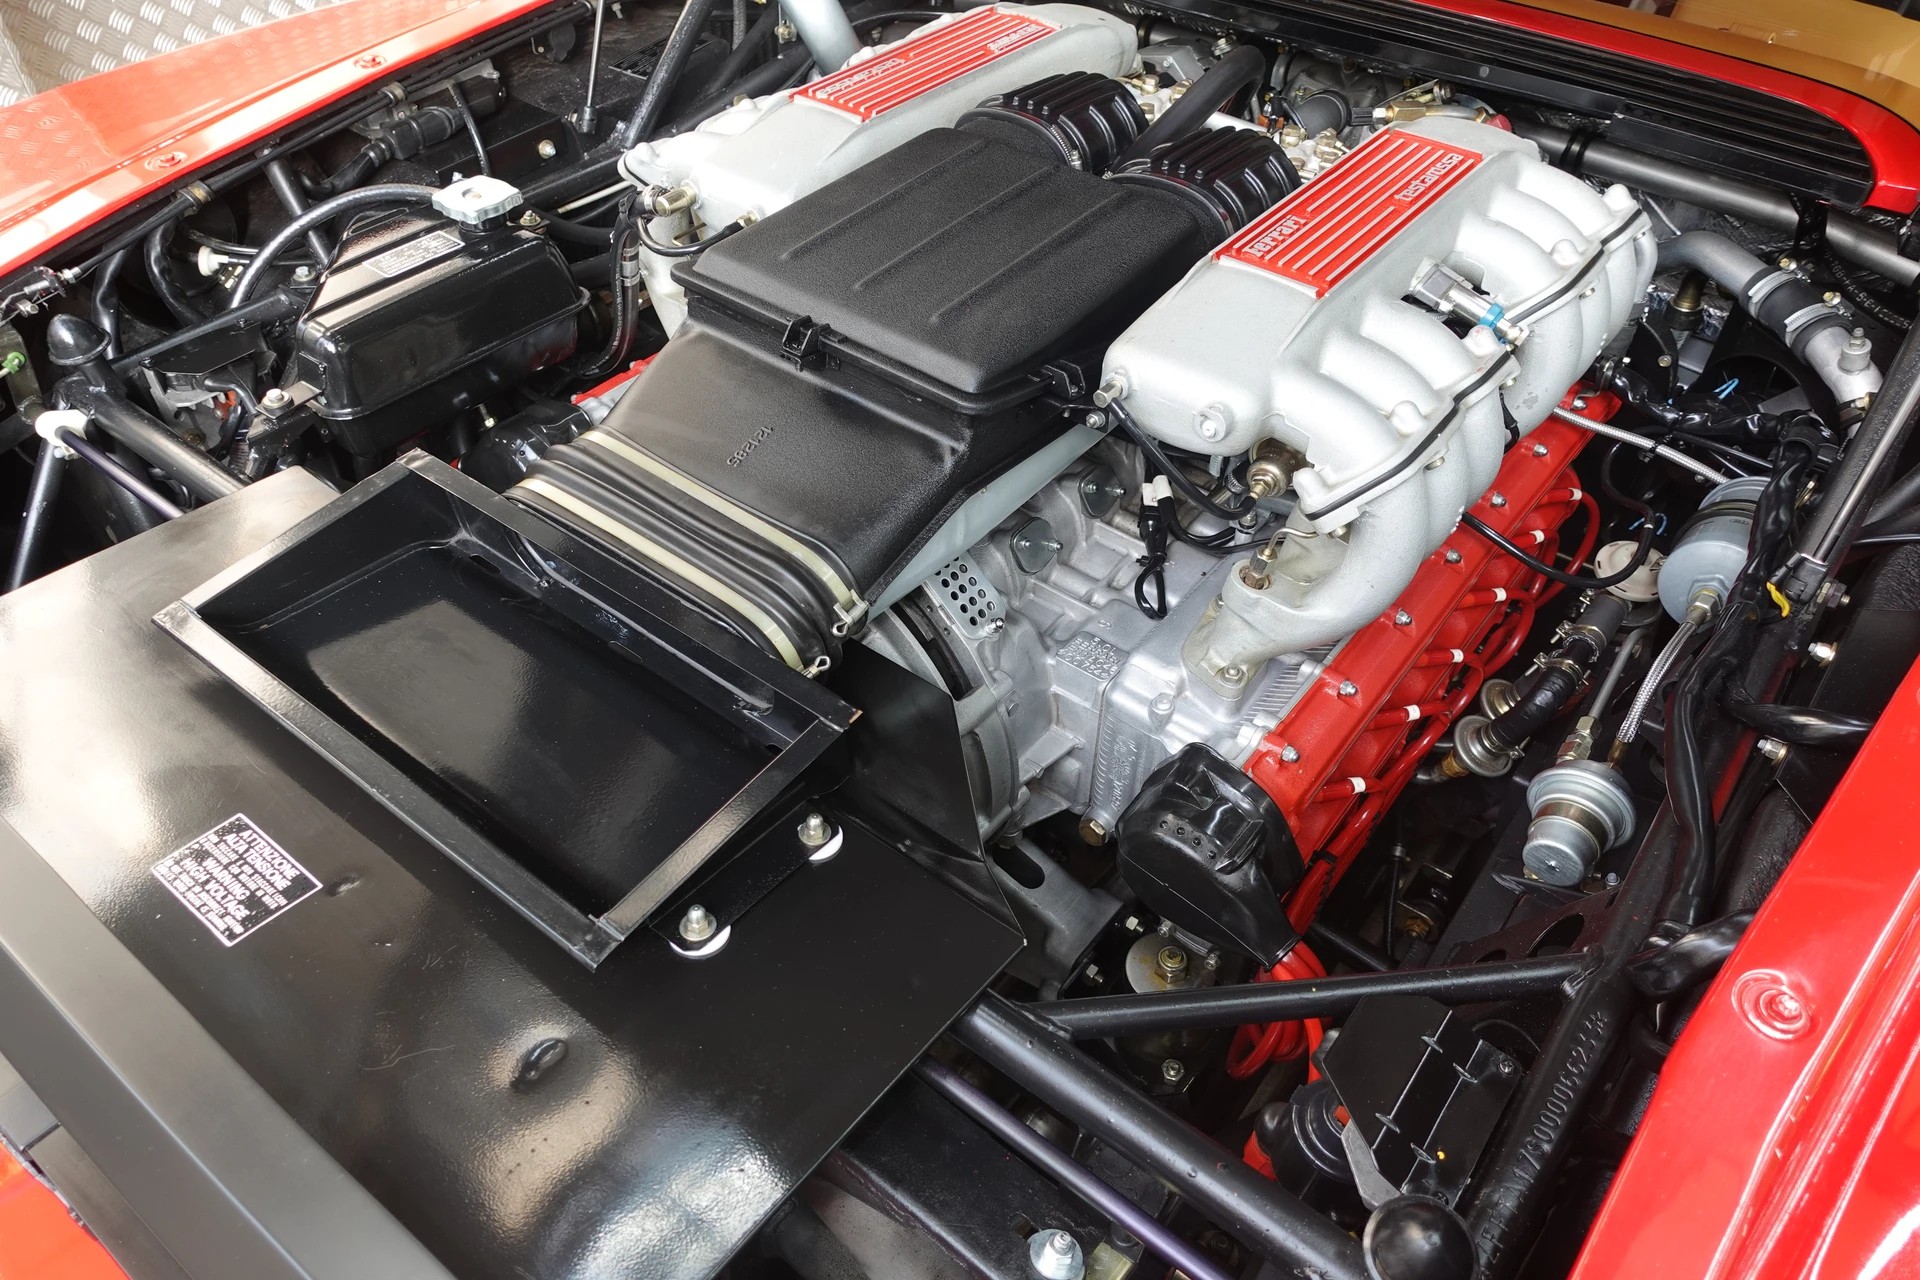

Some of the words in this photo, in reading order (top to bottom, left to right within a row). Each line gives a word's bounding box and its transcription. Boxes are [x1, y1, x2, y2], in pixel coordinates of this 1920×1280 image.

[1395, 152, 1464, 204] testarossa
[726, 426, 774, 468] 121285
[199, 855, 252, 901] WARNING
[221, 831, 251, 854] ALTA
[240, 847, 292, 891] TENSIONE
[237, 827, 301, 880] ATTENZIONE
[178, 856, 210, 883] HIGH
[202, 879, 250, 921] VOLTAGE
